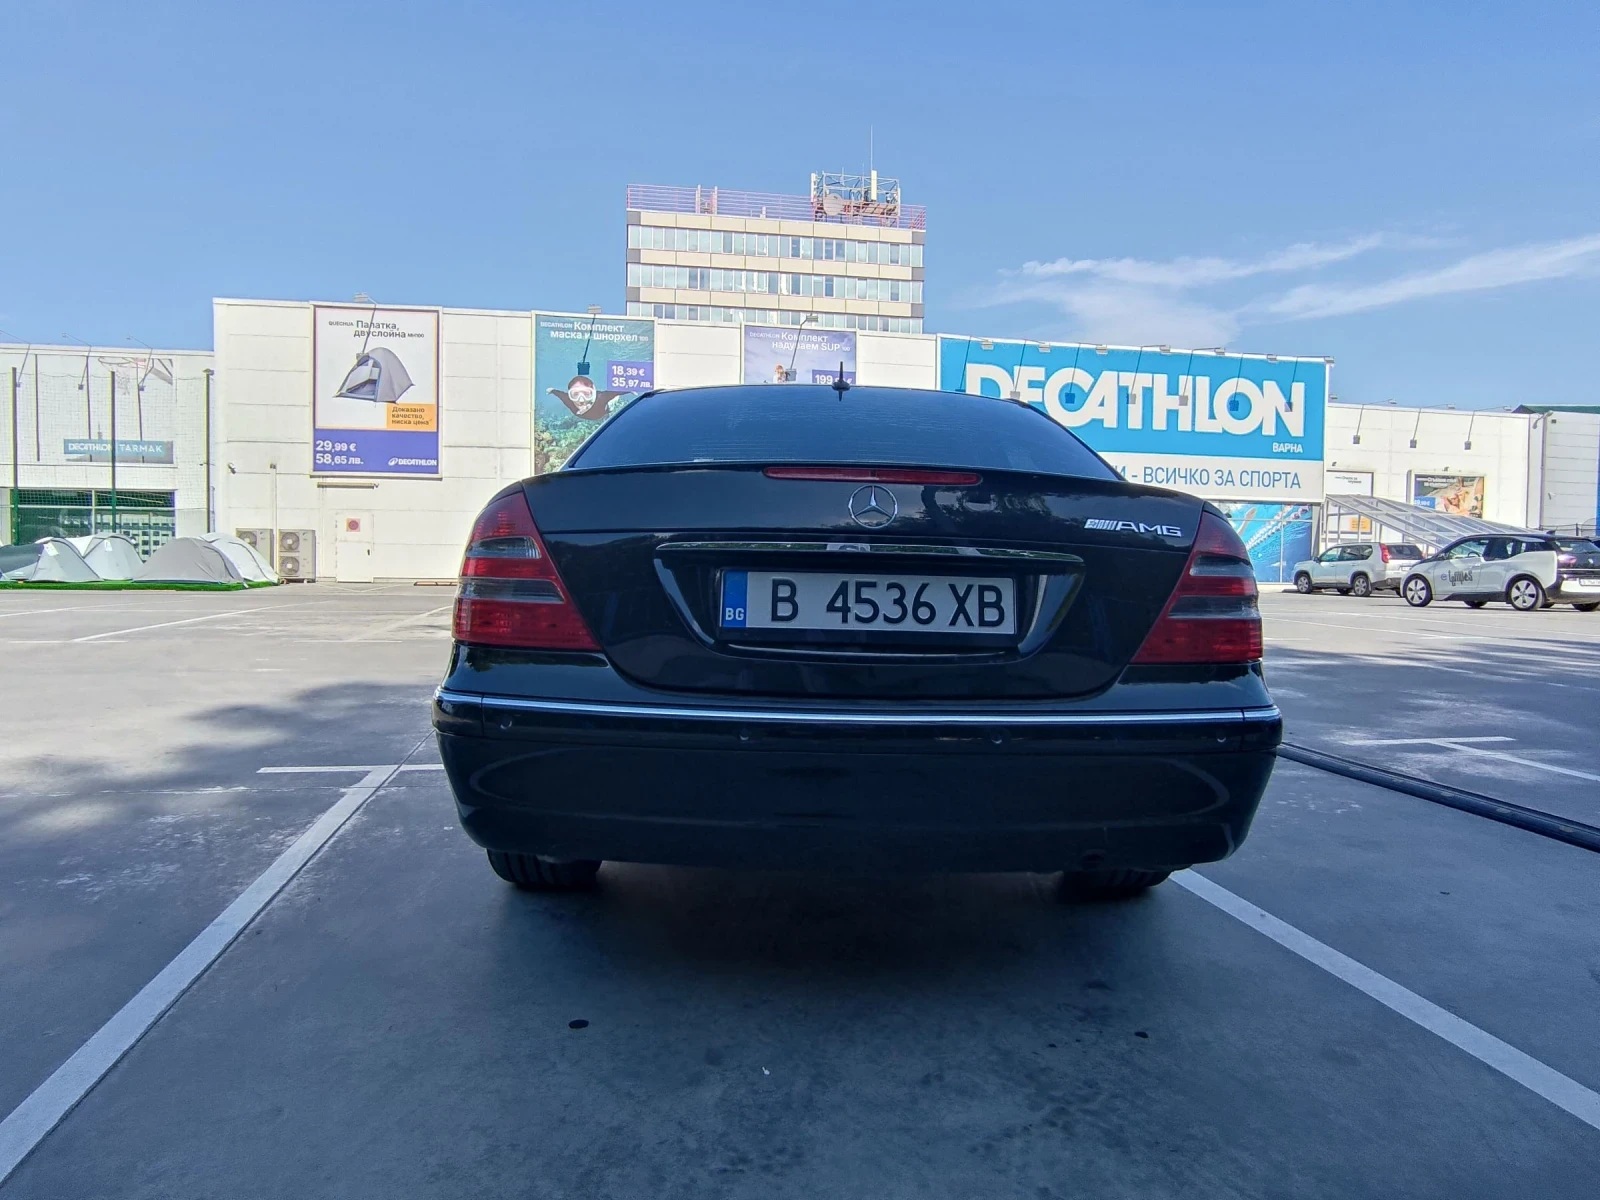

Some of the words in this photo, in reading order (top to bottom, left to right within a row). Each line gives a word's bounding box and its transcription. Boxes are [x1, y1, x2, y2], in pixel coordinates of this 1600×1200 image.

[356, 320, 400, 331] Палатка,
[573, 321, 625, 333] Комплект
[354, 329, 406, 338] двуслойна
[550, 330, 582, 339] маска
[593, 332, 638, 342] шнорхел
[749, 331, 780, 339] DECATHLON
[781, 331, 829, 343] Комплект
[821, 342, 841, 351] SUP
[611, 365, 638, 377] 18,39
[639, 368, 645, 376] €
[611, 377, 639, 389] 35,97
[640, 381, 653, 389] лв.
[965, 362, 1305, 437] DECATHLON
[119, 443, 163, 453] TARMAK
[315, 440, 348, 452] 29,99
[349, 442, 357, 451] €
[1272, 442, 1304, 454] ВАРНА
[315, 453, 347, 466] 58,65
[348, 456, 364, 465] лв.
[398, 458, 438, 466] DECATHLON
[1143, 466, 1210, 486] ВСИЧКО
[1214, 469, 1235, 487] ЗА
[1239, 471, 1301, 489] СПОРТА
[1116, 520, 1182, 537] AMG
[771, 578, 799, 622] B
[825, 580, 937, 625] 4536
[947, 583, 1005, 628] XB
[725, 606, 745, 621] BG
